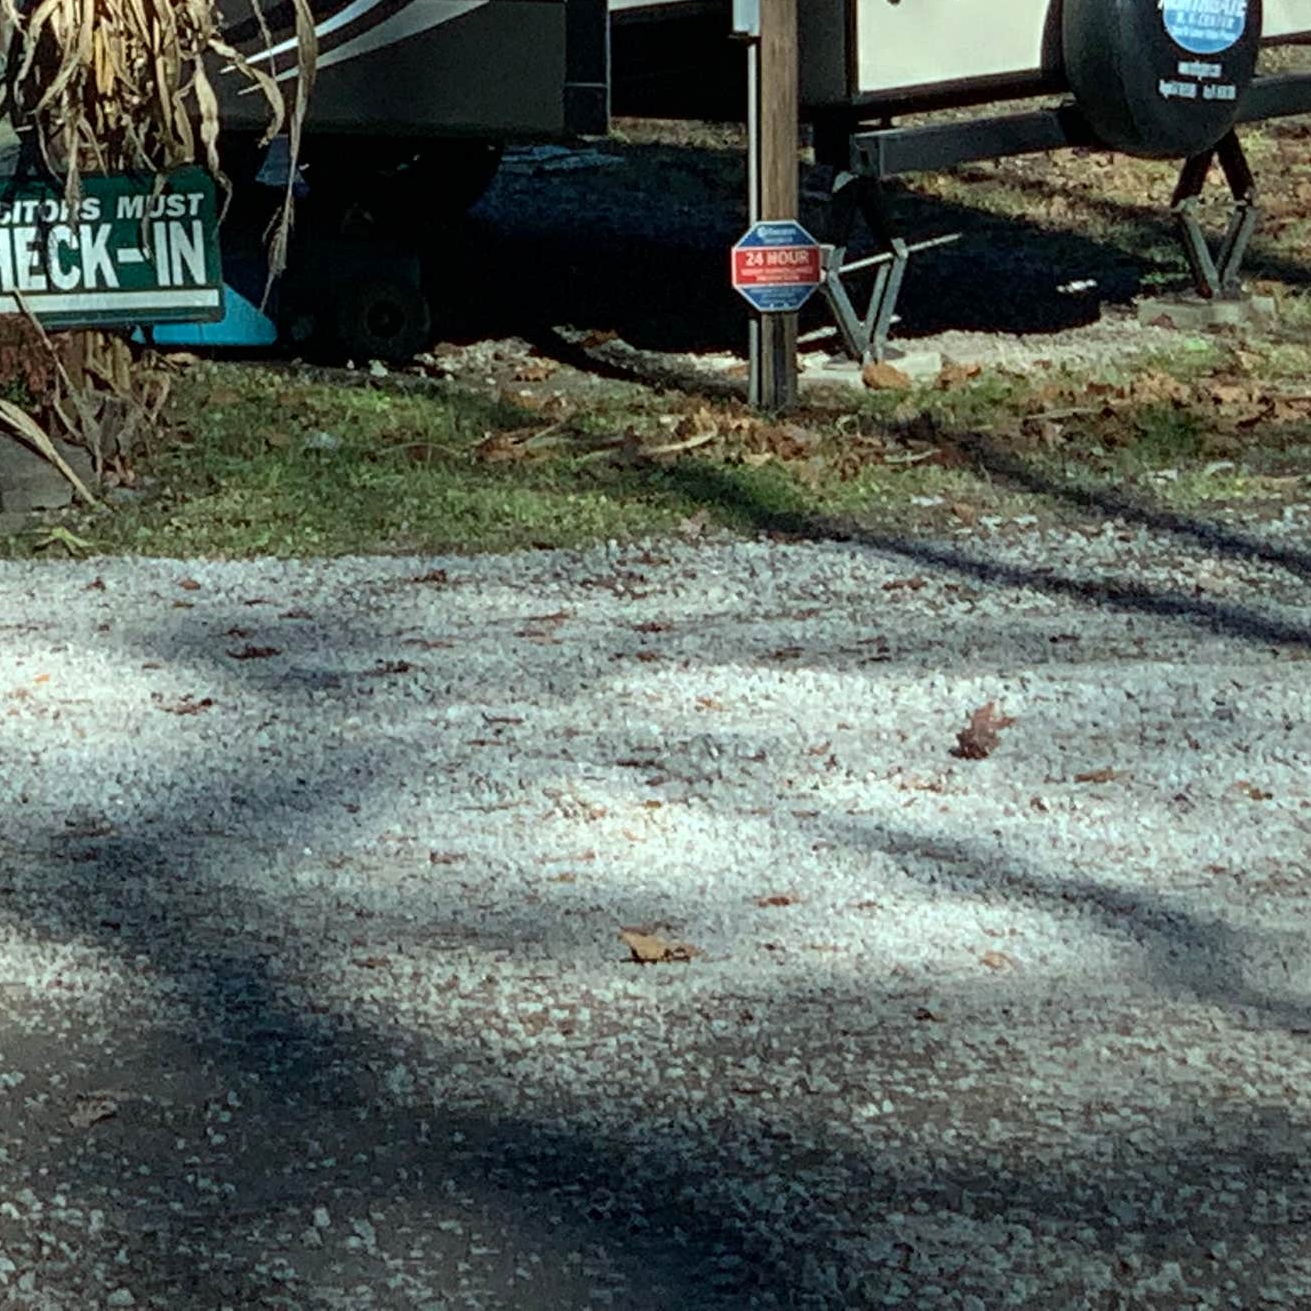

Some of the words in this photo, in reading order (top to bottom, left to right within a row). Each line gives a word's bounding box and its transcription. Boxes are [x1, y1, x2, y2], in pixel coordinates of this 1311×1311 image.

[117, 193, 205, 220] MUST
[745, 251, 764, 266] 24
[767, 251, 809, 266] HOUR
